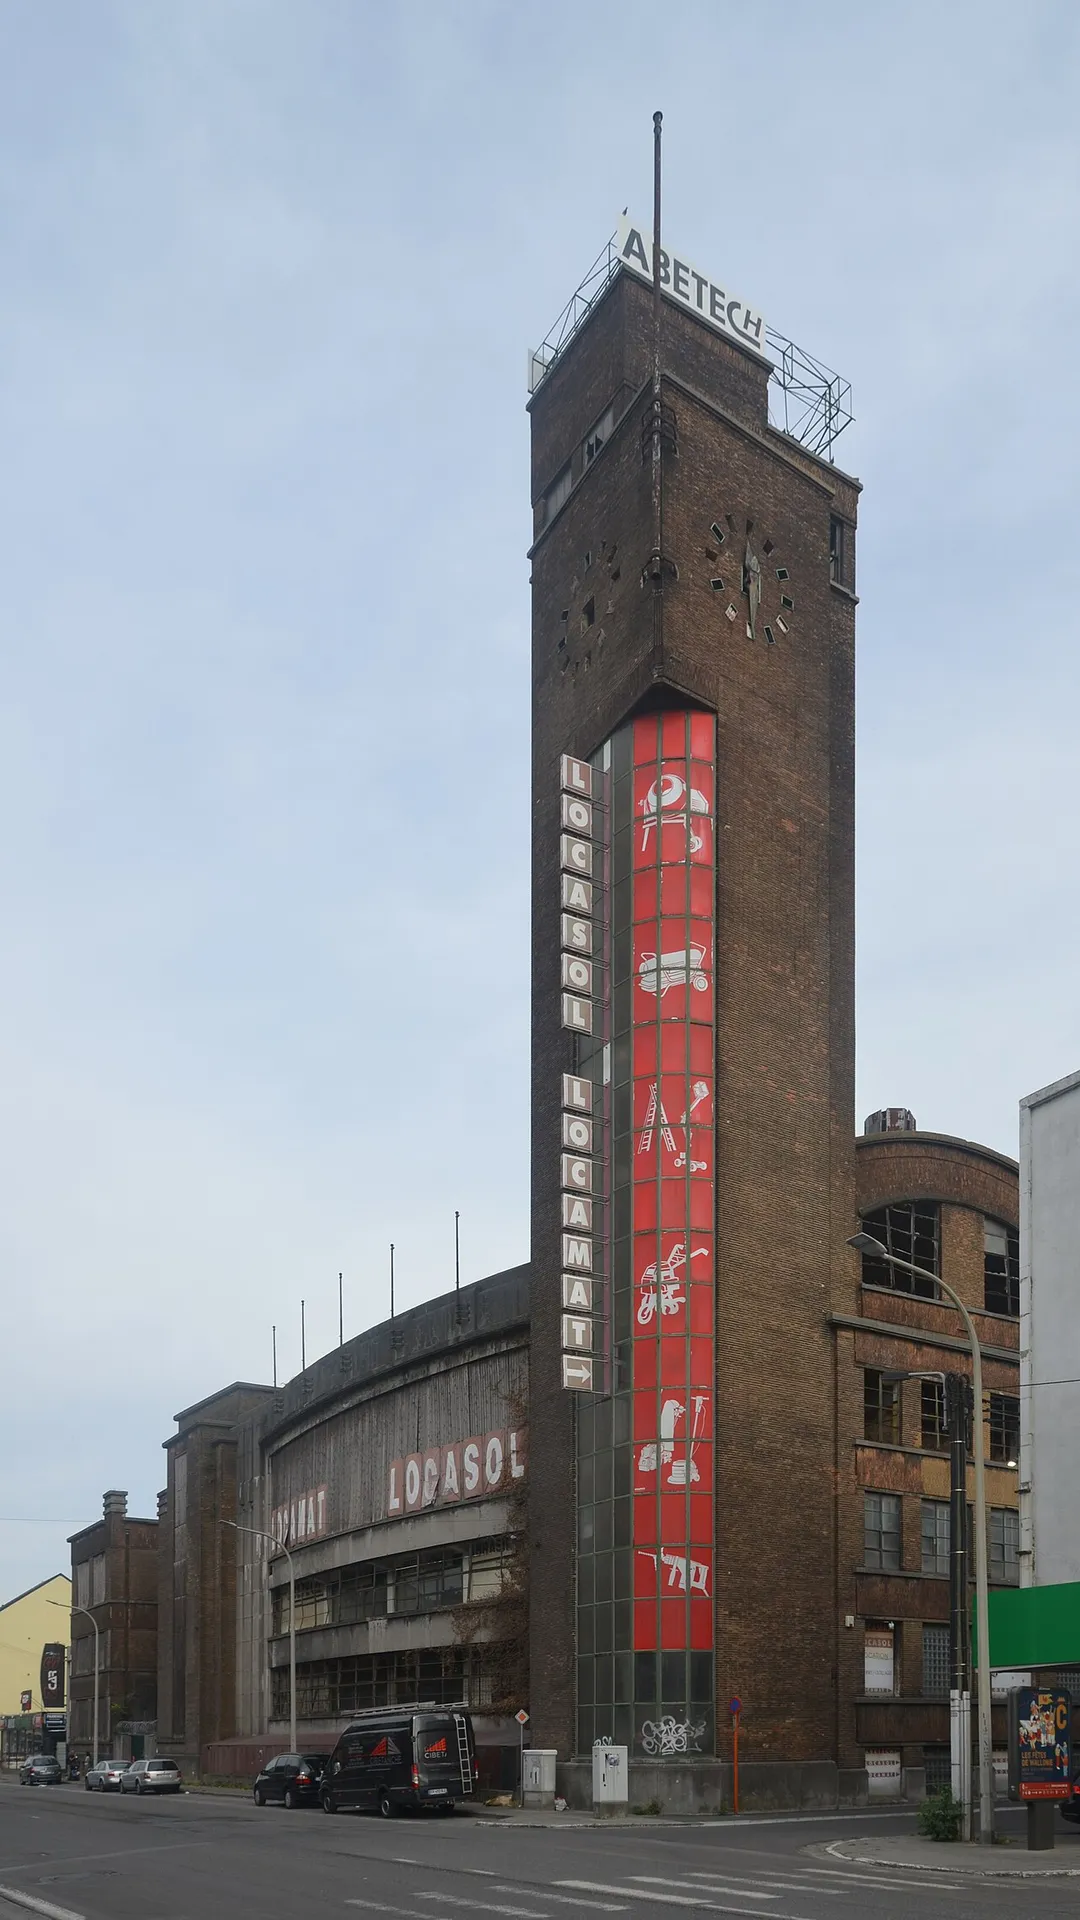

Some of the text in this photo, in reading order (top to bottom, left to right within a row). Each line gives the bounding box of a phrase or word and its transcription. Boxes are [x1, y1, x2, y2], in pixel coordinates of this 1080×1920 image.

[622, 228, 761, 349] ABETECH
[569, 762, 589, 1027] LOCASOL
[568, 1080, 590, 1345] LOCAMAT
[389, 1432, 525, 1510] LOCASOL
